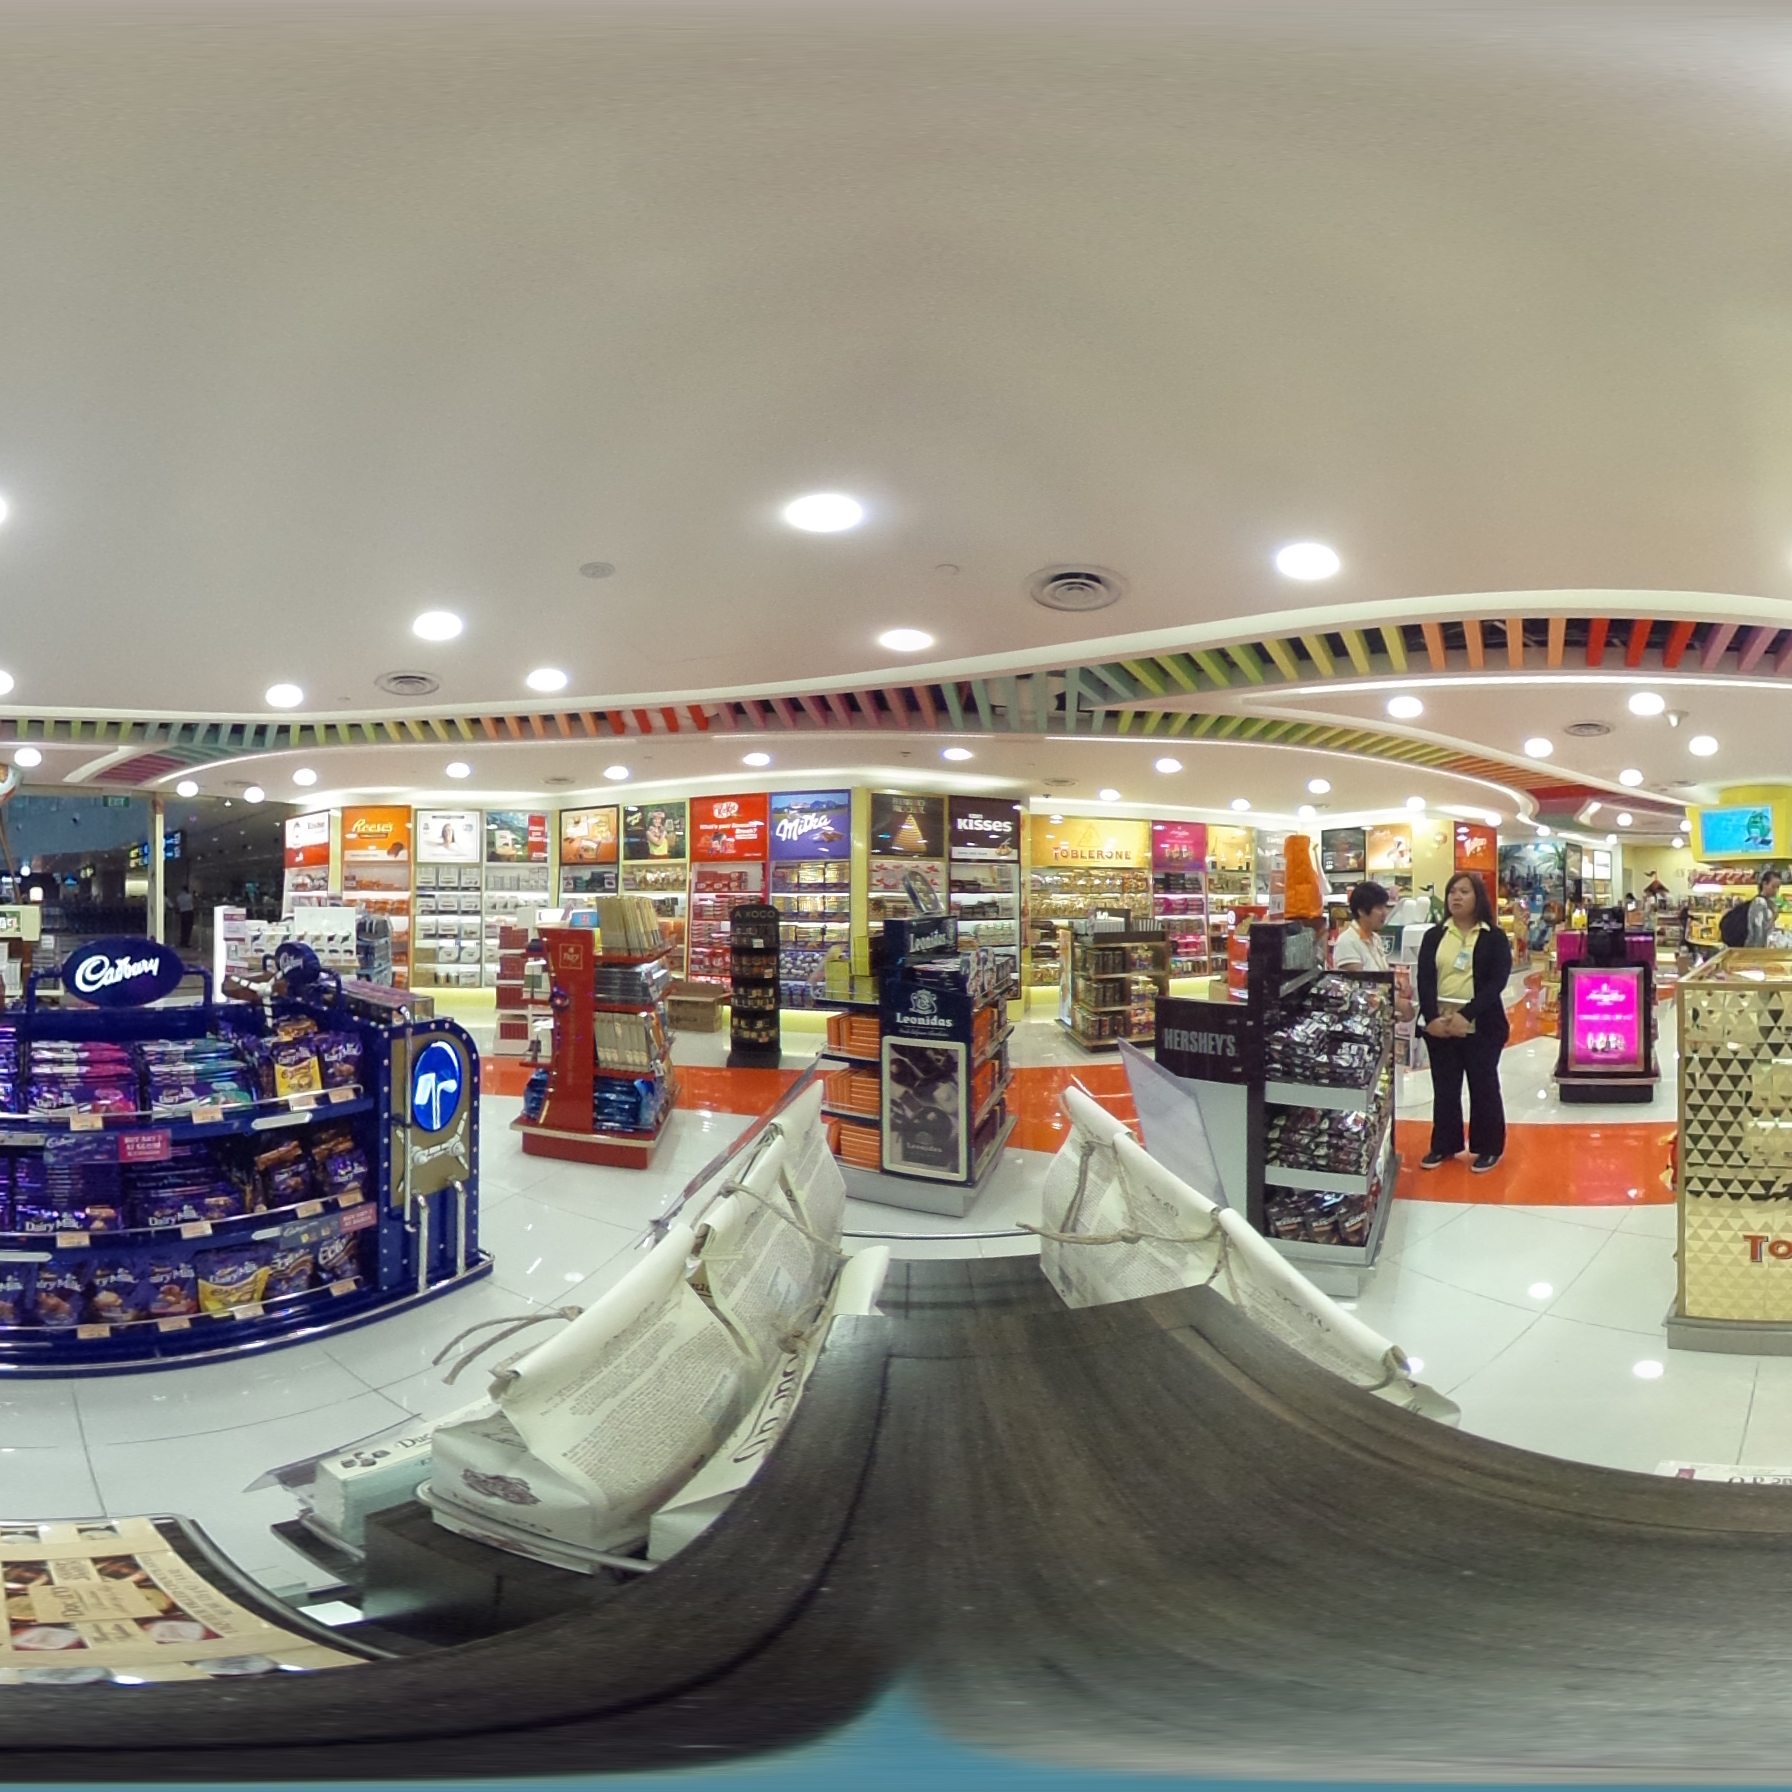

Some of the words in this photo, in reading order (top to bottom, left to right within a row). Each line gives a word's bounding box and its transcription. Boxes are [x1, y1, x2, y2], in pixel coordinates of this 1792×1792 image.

[775, 812, 832, 841] Milka
[1053, 846, 1132, 861] TOBLERONE
[909, 932, 946, 953] Leonidas
[75, 953, 160, 992] Cadbury
[895, 1012, 953, 1028] Leonidas
[1164, 1028, 1236, 1057] HERSHEY'S
[25, 1220, 55, 1233] Dairy
[149, 1215, 176, 1228] Dairy
[397, 1430, 431, 1450] Duc
[57, 1600, 83, 1618] Duc
